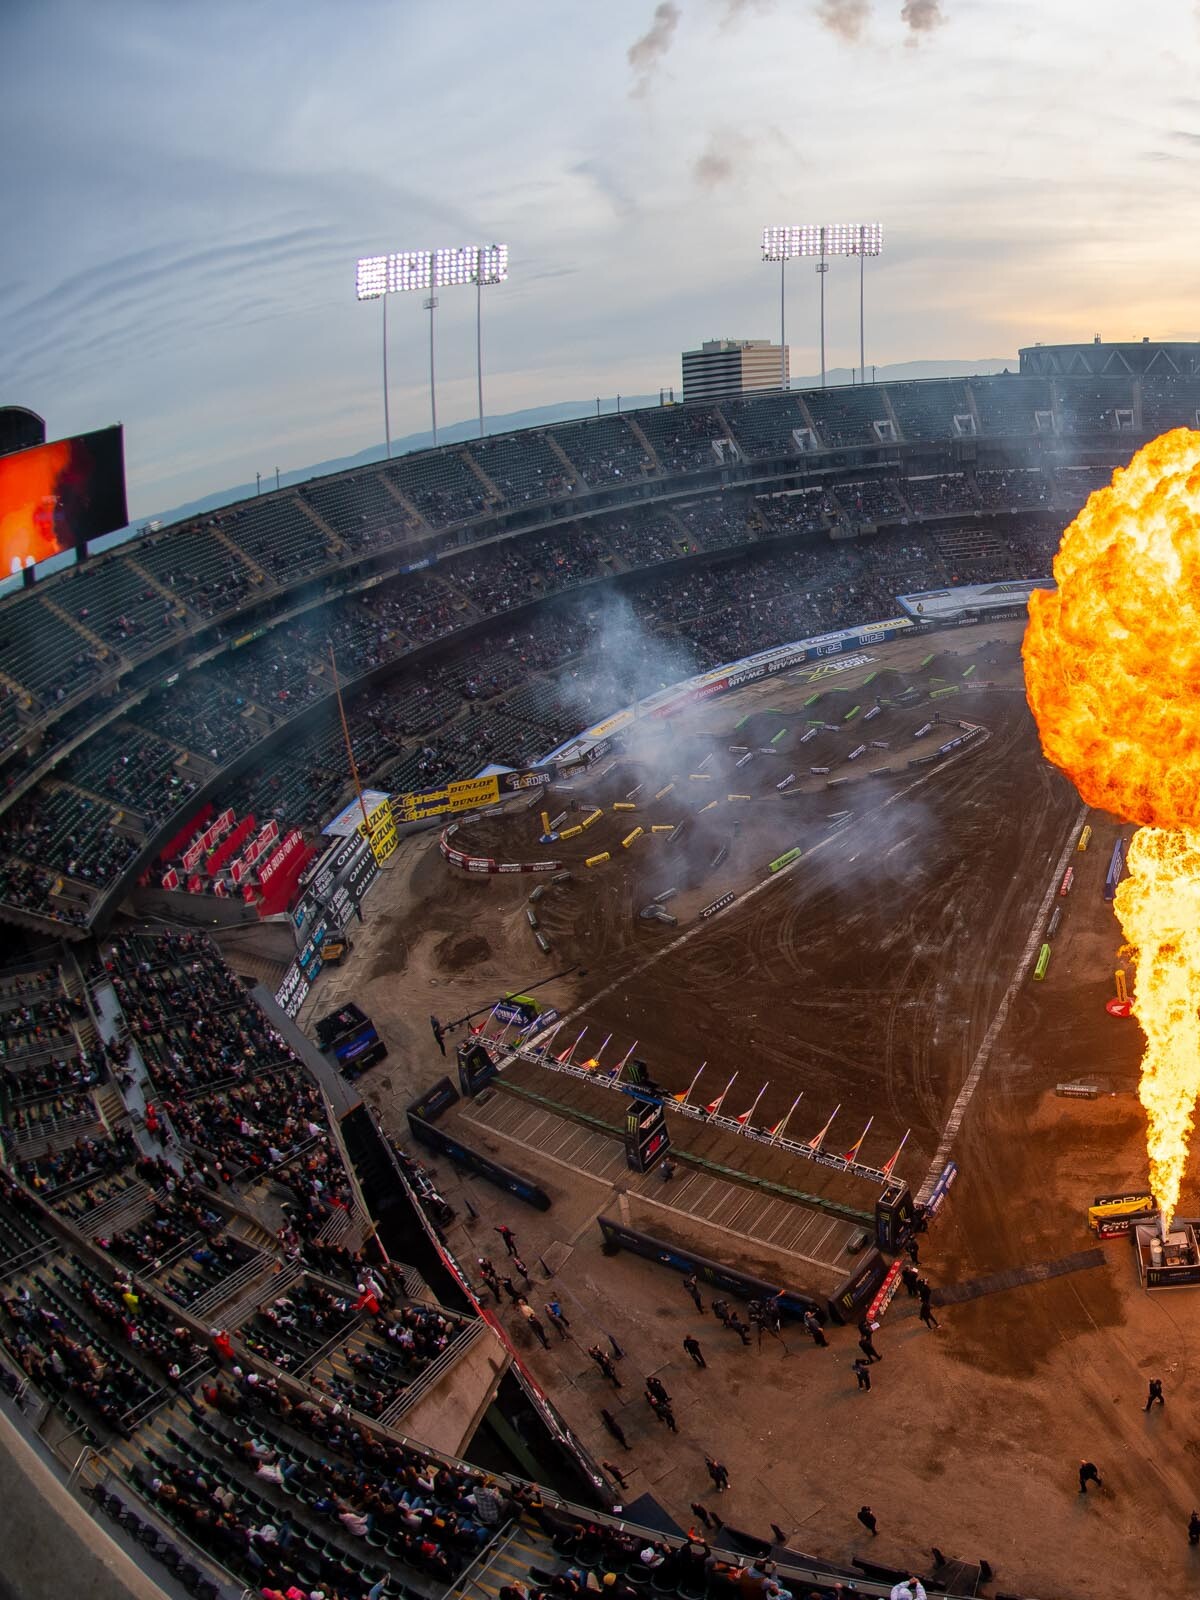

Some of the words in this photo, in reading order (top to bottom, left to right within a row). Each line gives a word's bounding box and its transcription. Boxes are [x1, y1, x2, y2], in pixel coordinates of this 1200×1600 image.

[450, 779, 494, 794] DUNLOP
[452, 792, 495, 807] DUNLOP
[711, 894, 734, 912] OAKLEY
